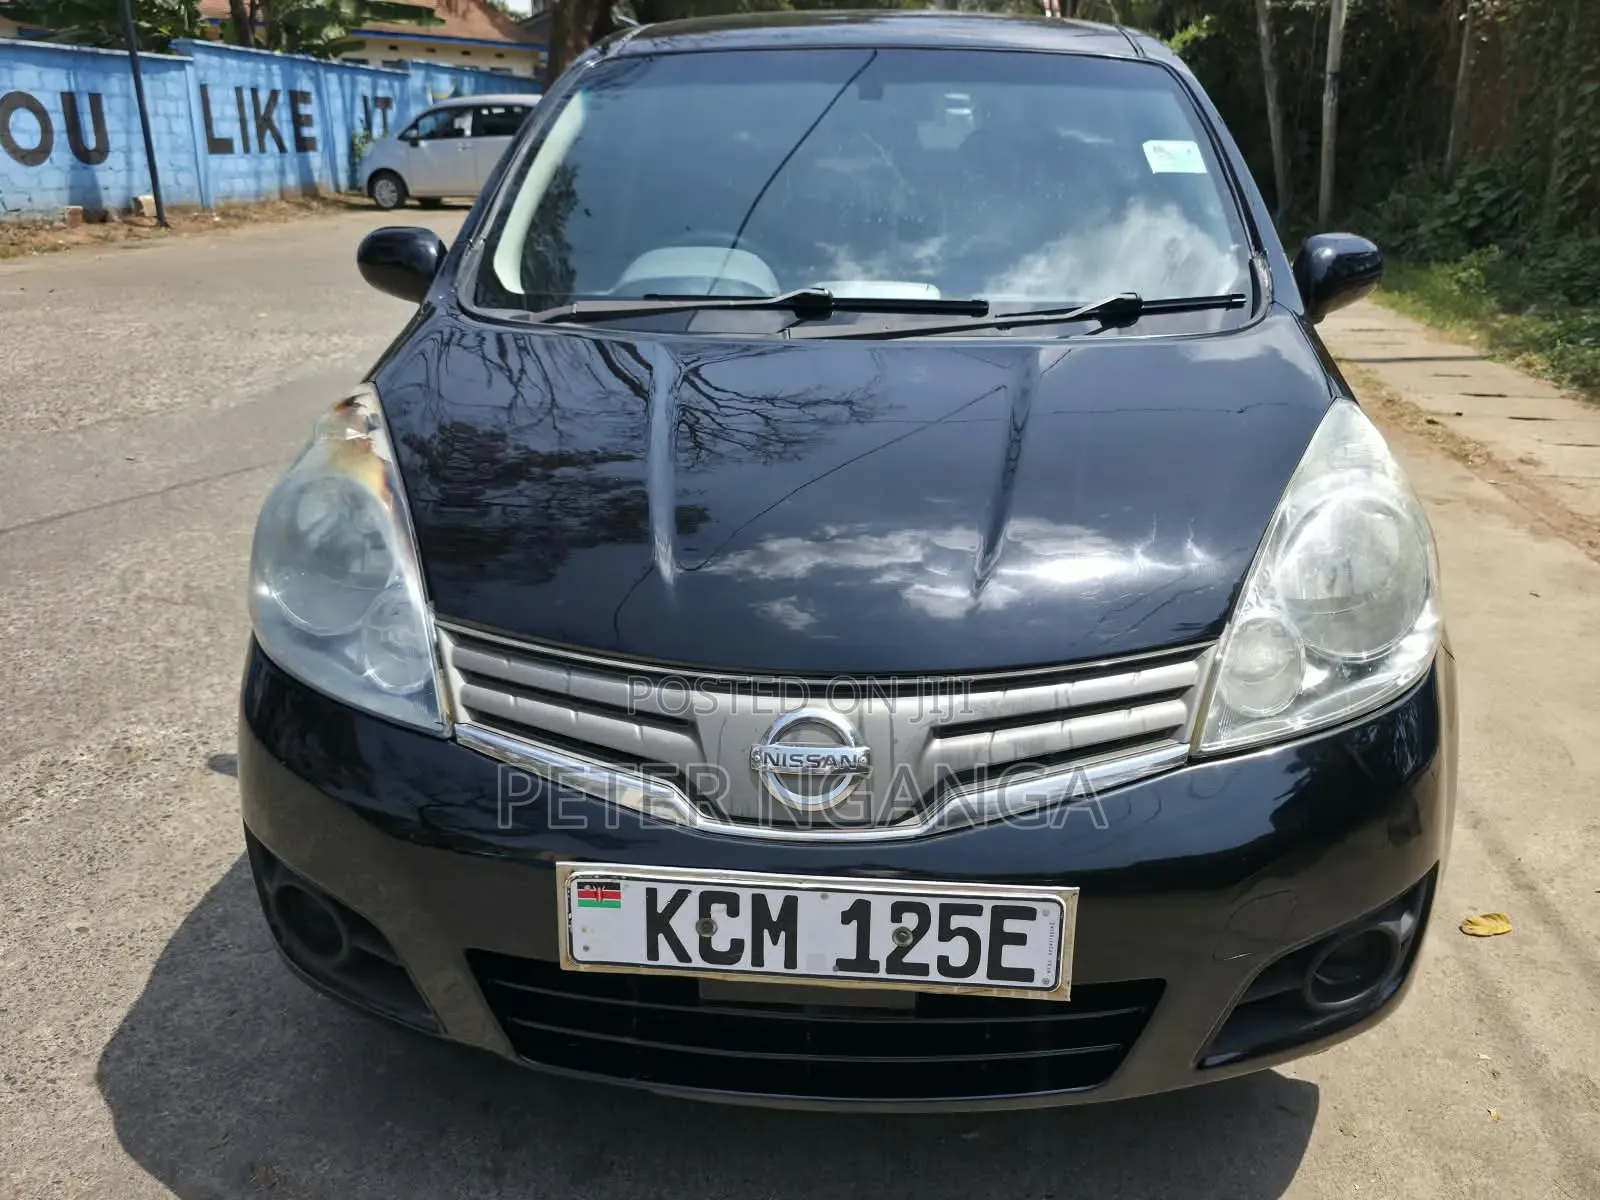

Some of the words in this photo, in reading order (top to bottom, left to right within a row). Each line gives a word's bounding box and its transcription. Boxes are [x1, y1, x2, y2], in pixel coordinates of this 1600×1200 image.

[200, 84, 317, 155] LIKE
[362, 96, 393, 138] IT
[763, 751, 858, 768] NISSAN
[645, 887, 798, 969] KCM
[836, 898, 1038, 982] 125E
